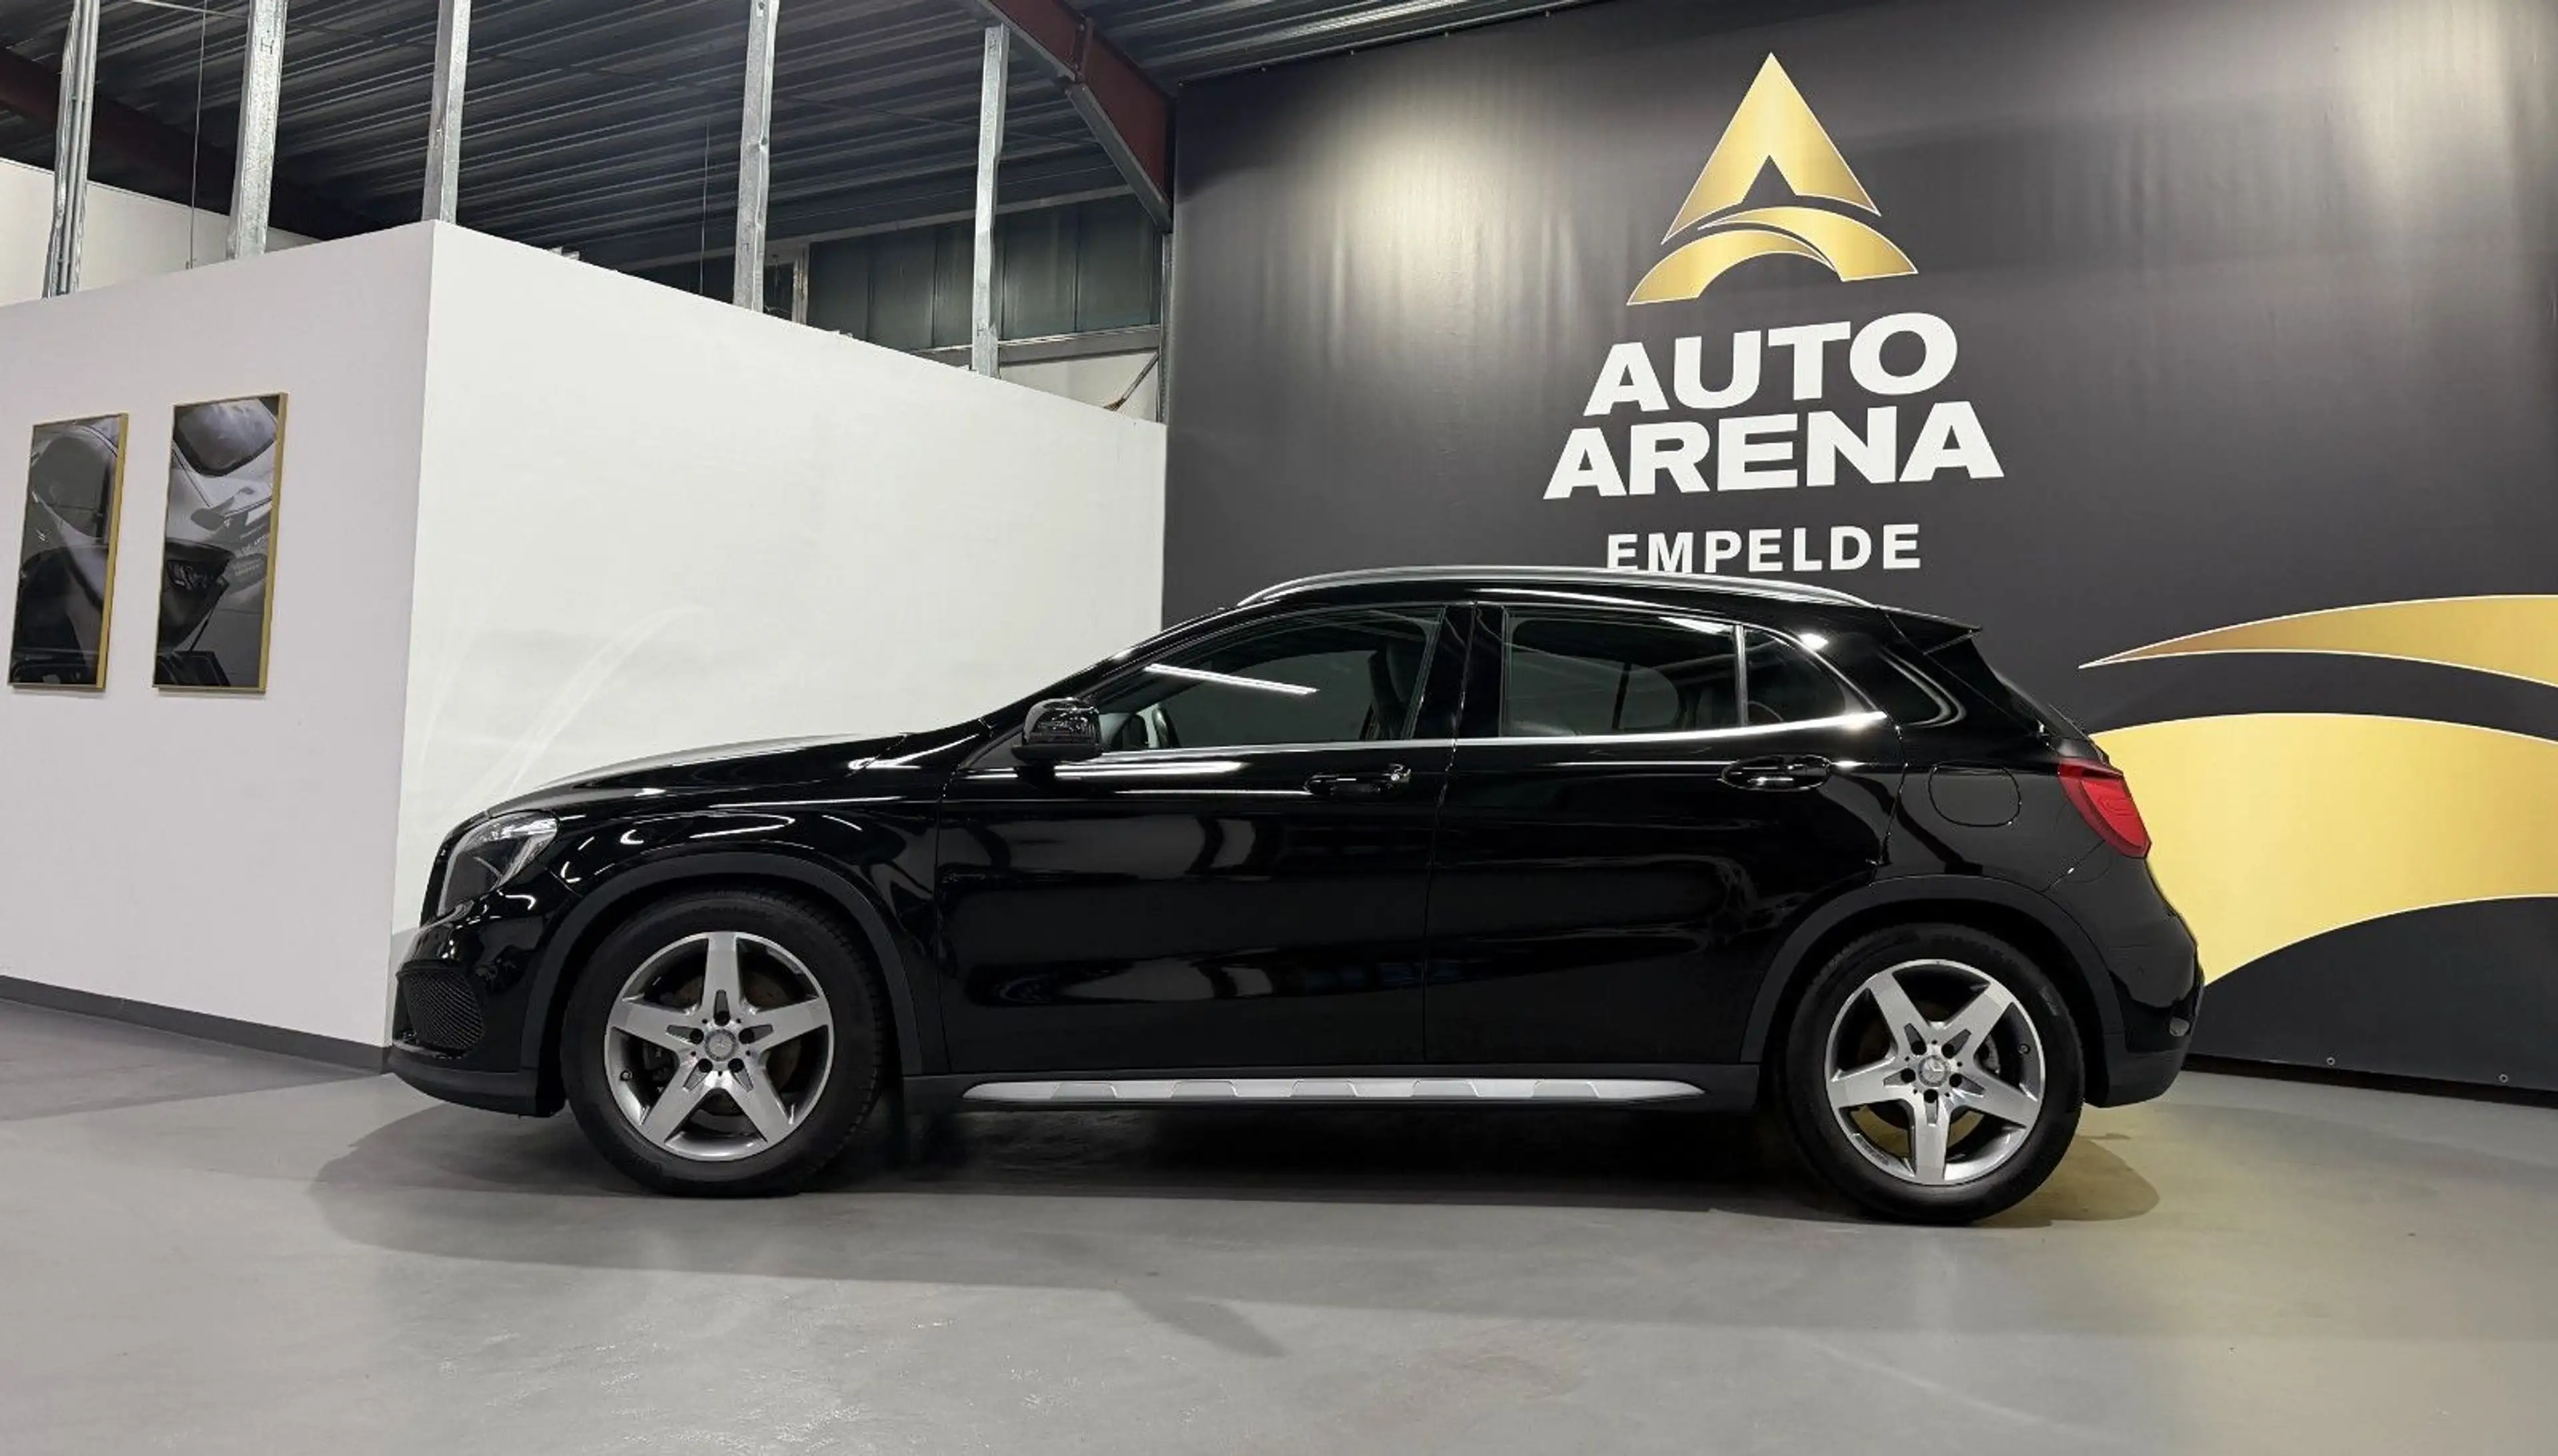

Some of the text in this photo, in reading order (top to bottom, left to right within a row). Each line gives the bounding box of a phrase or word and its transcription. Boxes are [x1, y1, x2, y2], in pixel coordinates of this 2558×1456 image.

[1583, 312, 1958, 417] AUTO
[1543, 401, 2004, 500] ARENA
[1607, 524, 1921, 573] EMPELDE
